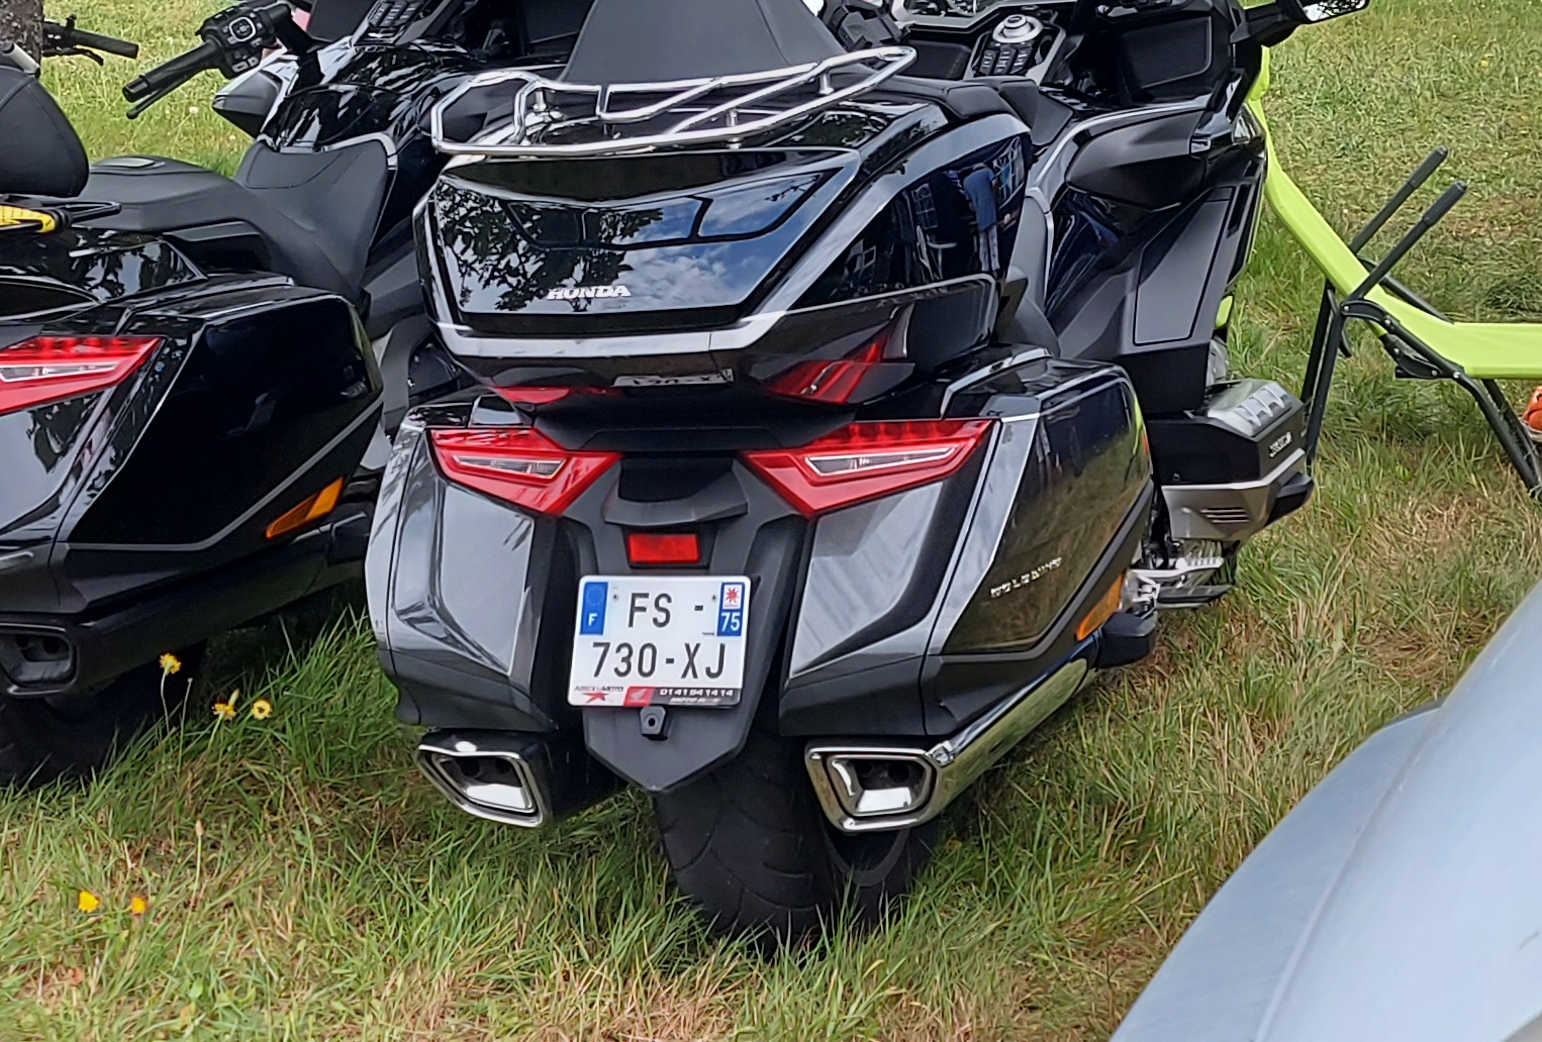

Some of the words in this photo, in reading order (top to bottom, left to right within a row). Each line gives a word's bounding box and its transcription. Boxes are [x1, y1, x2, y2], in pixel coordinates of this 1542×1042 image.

[547, 285, 632, 300] HONDA
[588, 613, 598, 627] F
[721, 612, 741, 632] 75
[592, 642, 726, 679] 730-XJ
